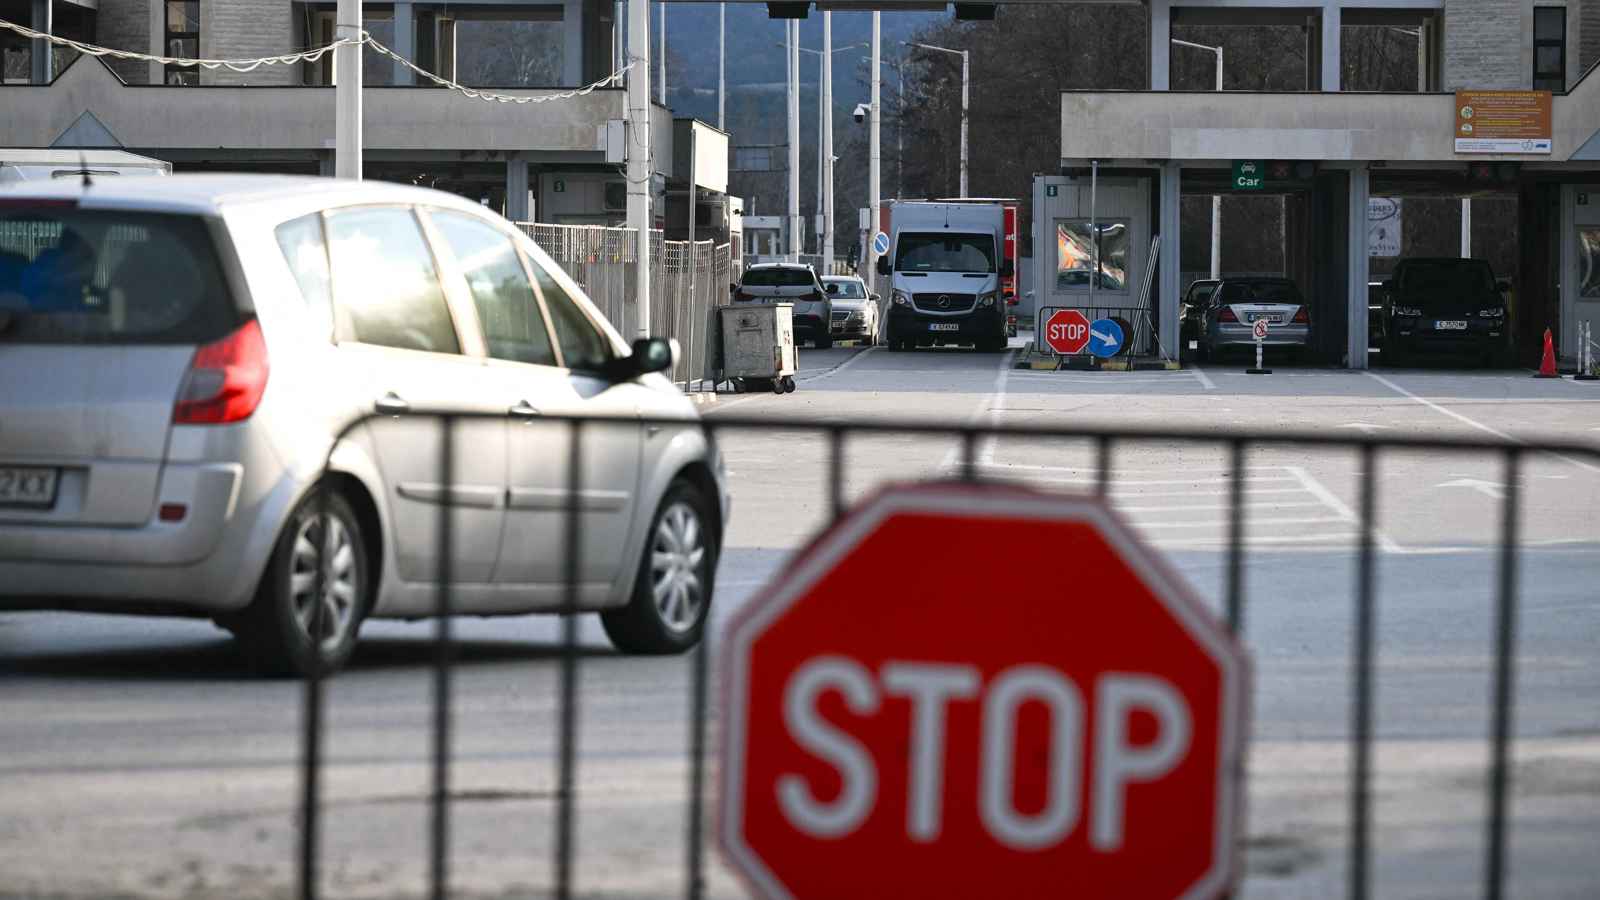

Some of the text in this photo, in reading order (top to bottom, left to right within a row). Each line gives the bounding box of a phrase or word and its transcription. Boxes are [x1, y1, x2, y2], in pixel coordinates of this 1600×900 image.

[1237, 176, 1261, 186] Car
[1050, 323, 1087, 340] STOP
[774, 653, 1194, 853] STOP
